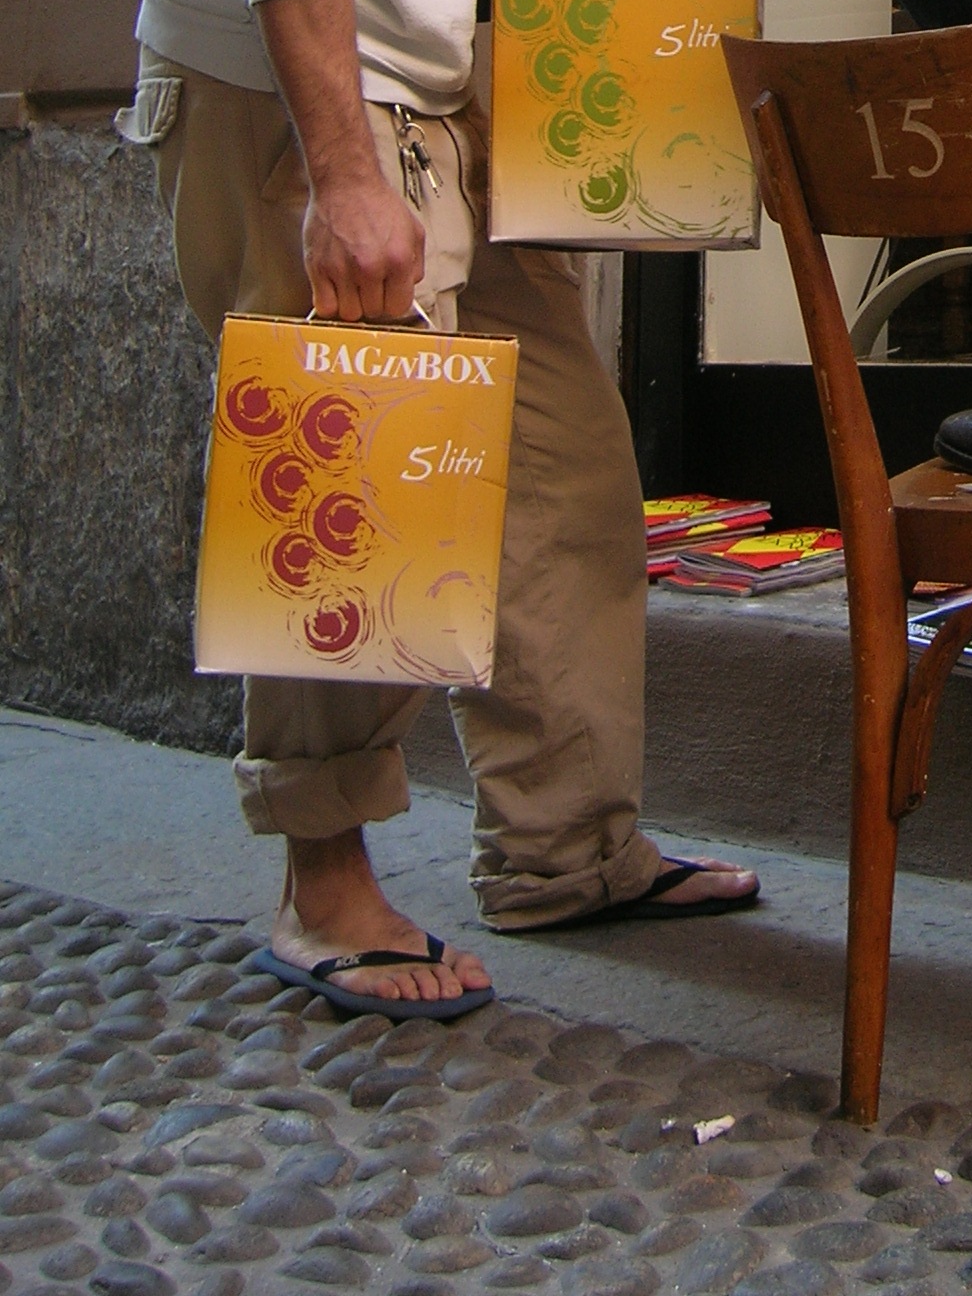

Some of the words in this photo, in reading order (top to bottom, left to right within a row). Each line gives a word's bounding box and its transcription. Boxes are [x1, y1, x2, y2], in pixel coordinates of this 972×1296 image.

[655, 23, 686, 57] 5
[687, 17, 731, 48] litr
[855, 97, 946, 180] 15
[400, 444, 438, 481] 5
[438, 439, 487, 476] litri
